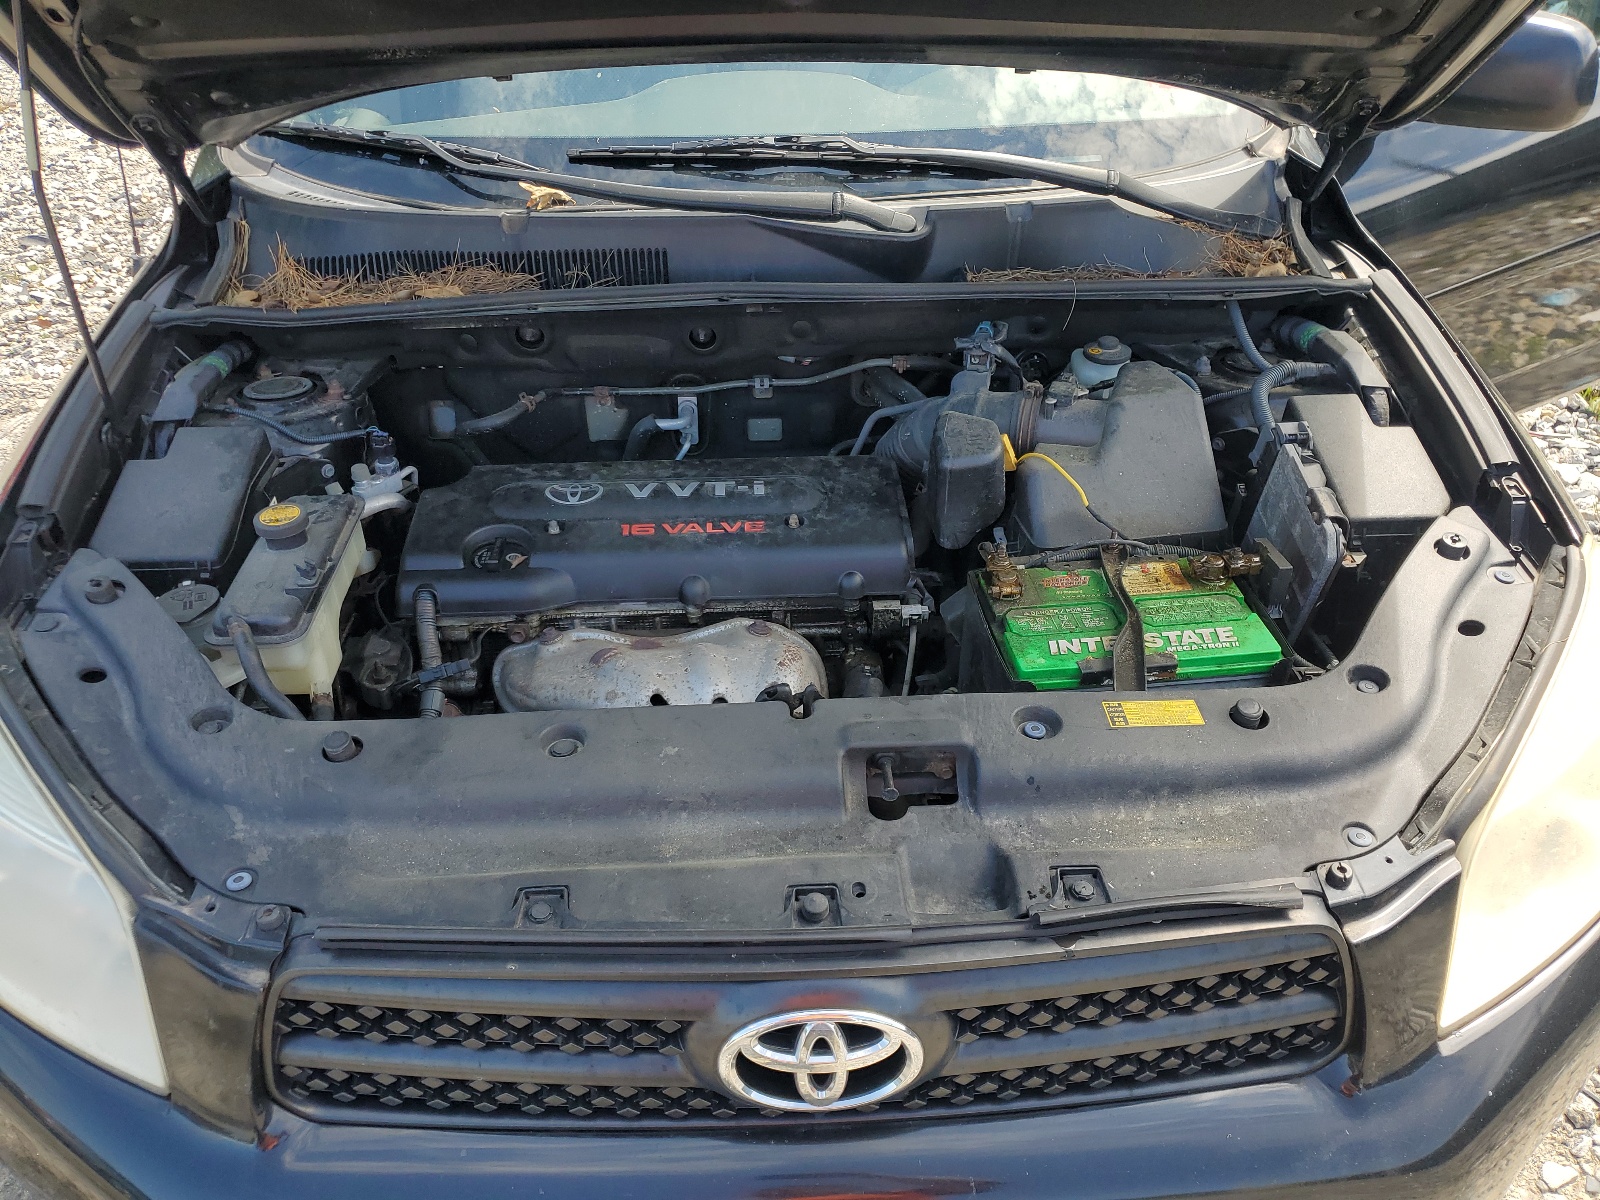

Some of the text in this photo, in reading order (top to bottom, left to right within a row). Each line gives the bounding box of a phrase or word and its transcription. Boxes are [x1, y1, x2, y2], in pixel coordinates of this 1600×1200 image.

[625, 481, 765, 498] VVT-i
[621, 520, 766, 536] 16 VALVE
[1048, 626, 1238, 656] INTESTATE
[1166, 643, 1229, 653] MEGA-TRON
